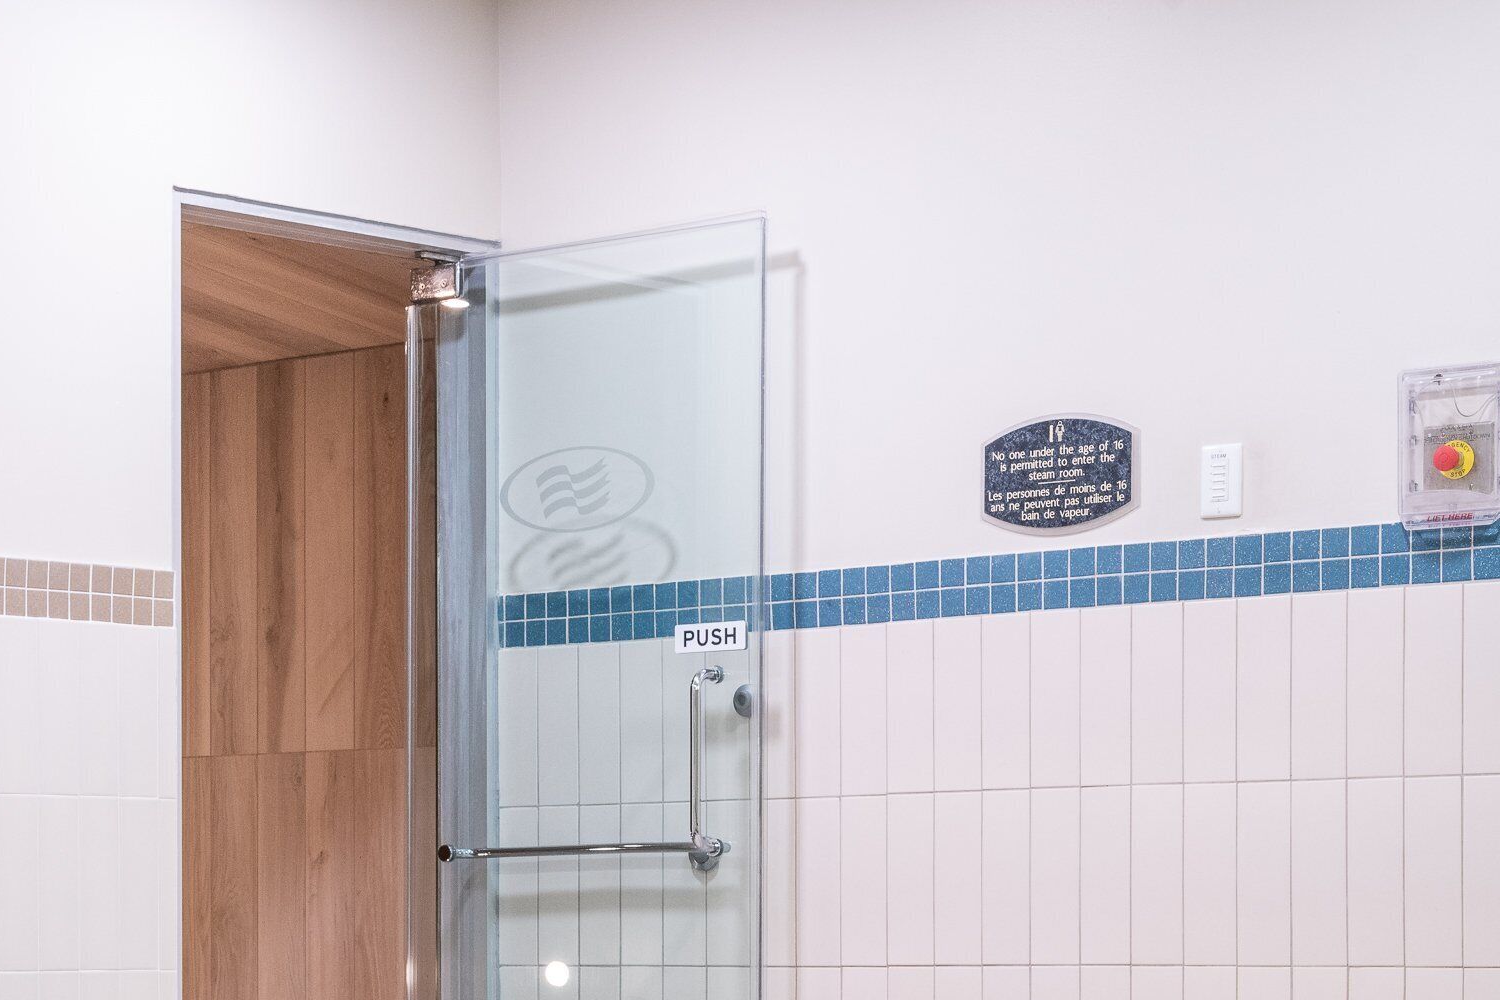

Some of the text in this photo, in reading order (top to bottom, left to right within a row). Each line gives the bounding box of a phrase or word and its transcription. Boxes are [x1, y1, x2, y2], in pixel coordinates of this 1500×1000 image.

[992, 439, 1124, 461] No one under the age of 16
[1000, 452, 1115, 474] is permitted to enter the
[1450, 468, 1466, 477] STOP
[1028, 468, 1086, 481] steam room.
[988, 479, 1127, 502] Les personnes de moins de 16
[990, 490, 1125, 512] ans ne peuvent pas utiliser le
[1021, 508, 1092, 521] bain de vapeur.
[1448, 512, 1474, 521] HERE
[683, 626, 737, 648] PUSH
